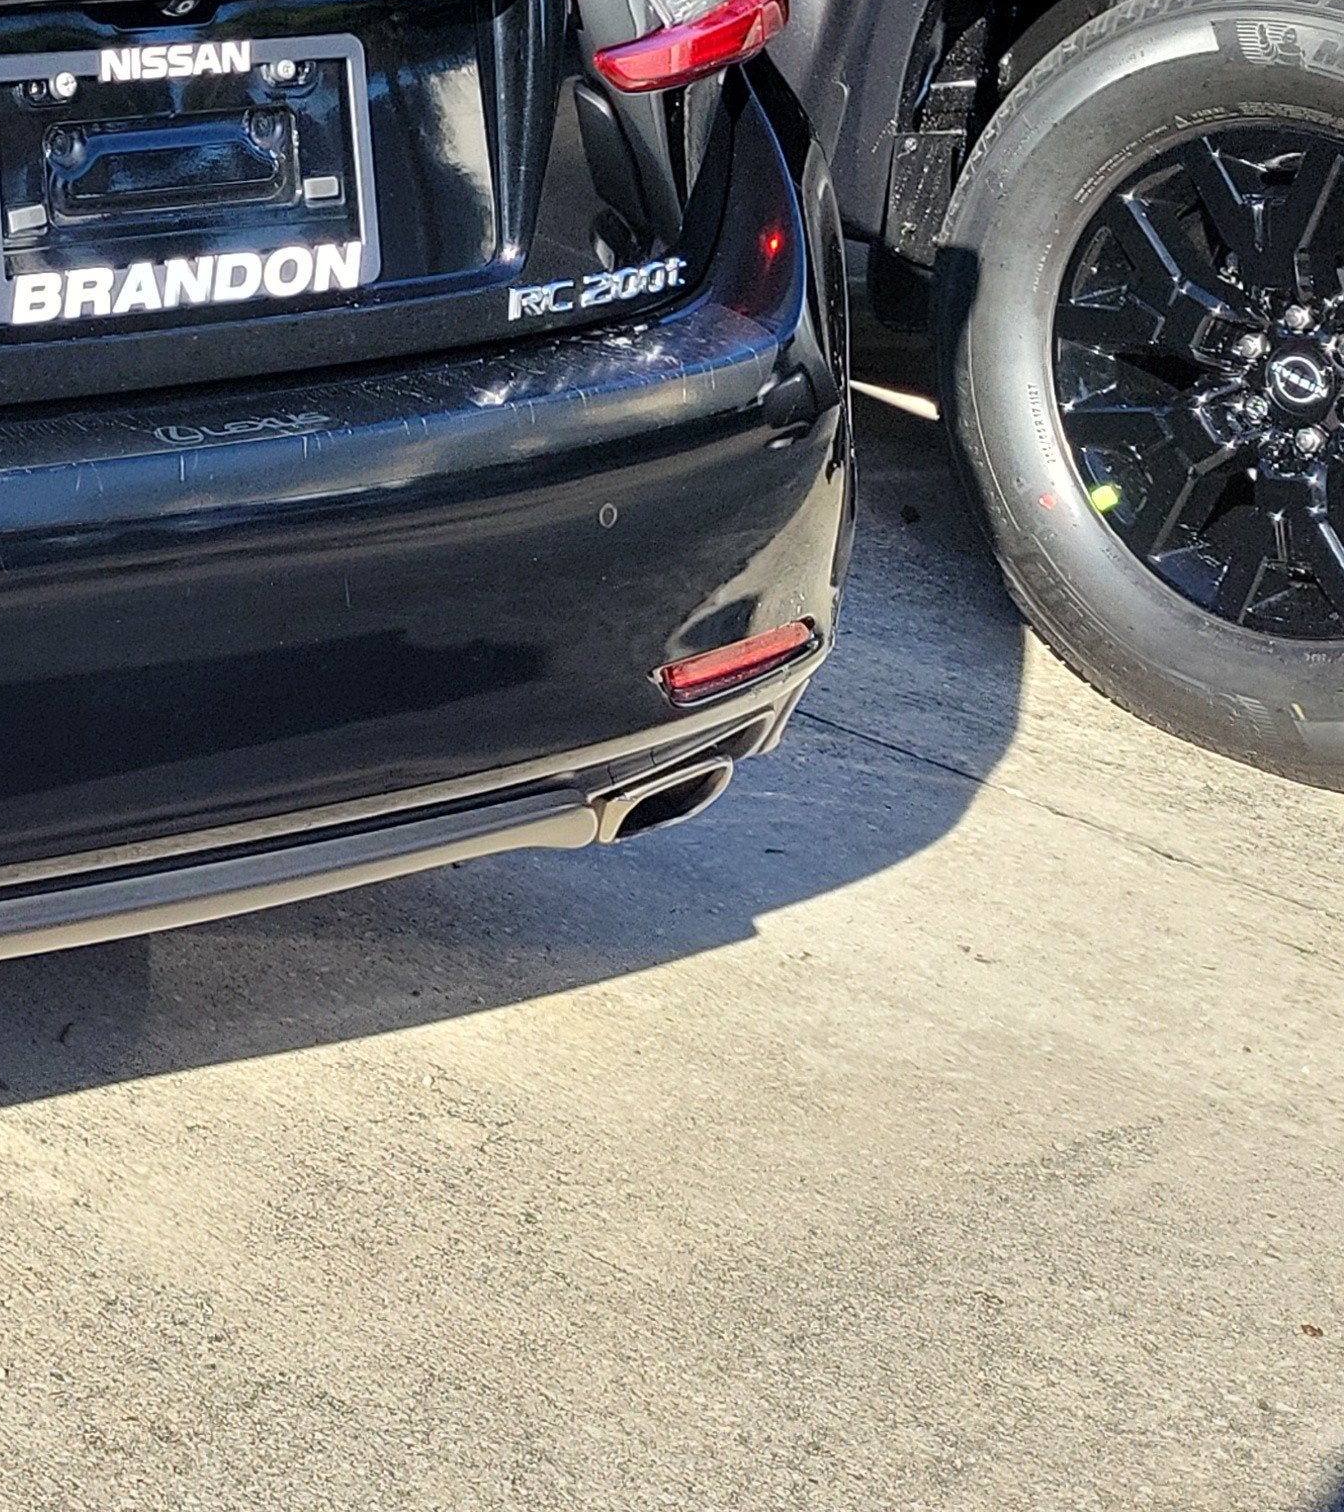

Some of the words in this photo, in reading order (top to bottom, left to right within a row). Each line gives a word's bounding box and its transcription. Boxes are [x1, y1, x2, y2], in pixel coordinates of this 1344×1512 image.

[100, 40, 251, 82] NISSAN
[11, 241, 363, 324] BRANDON
[508, 277, 574, 321] RC
[200, 411, 330, 436] LEXUS
